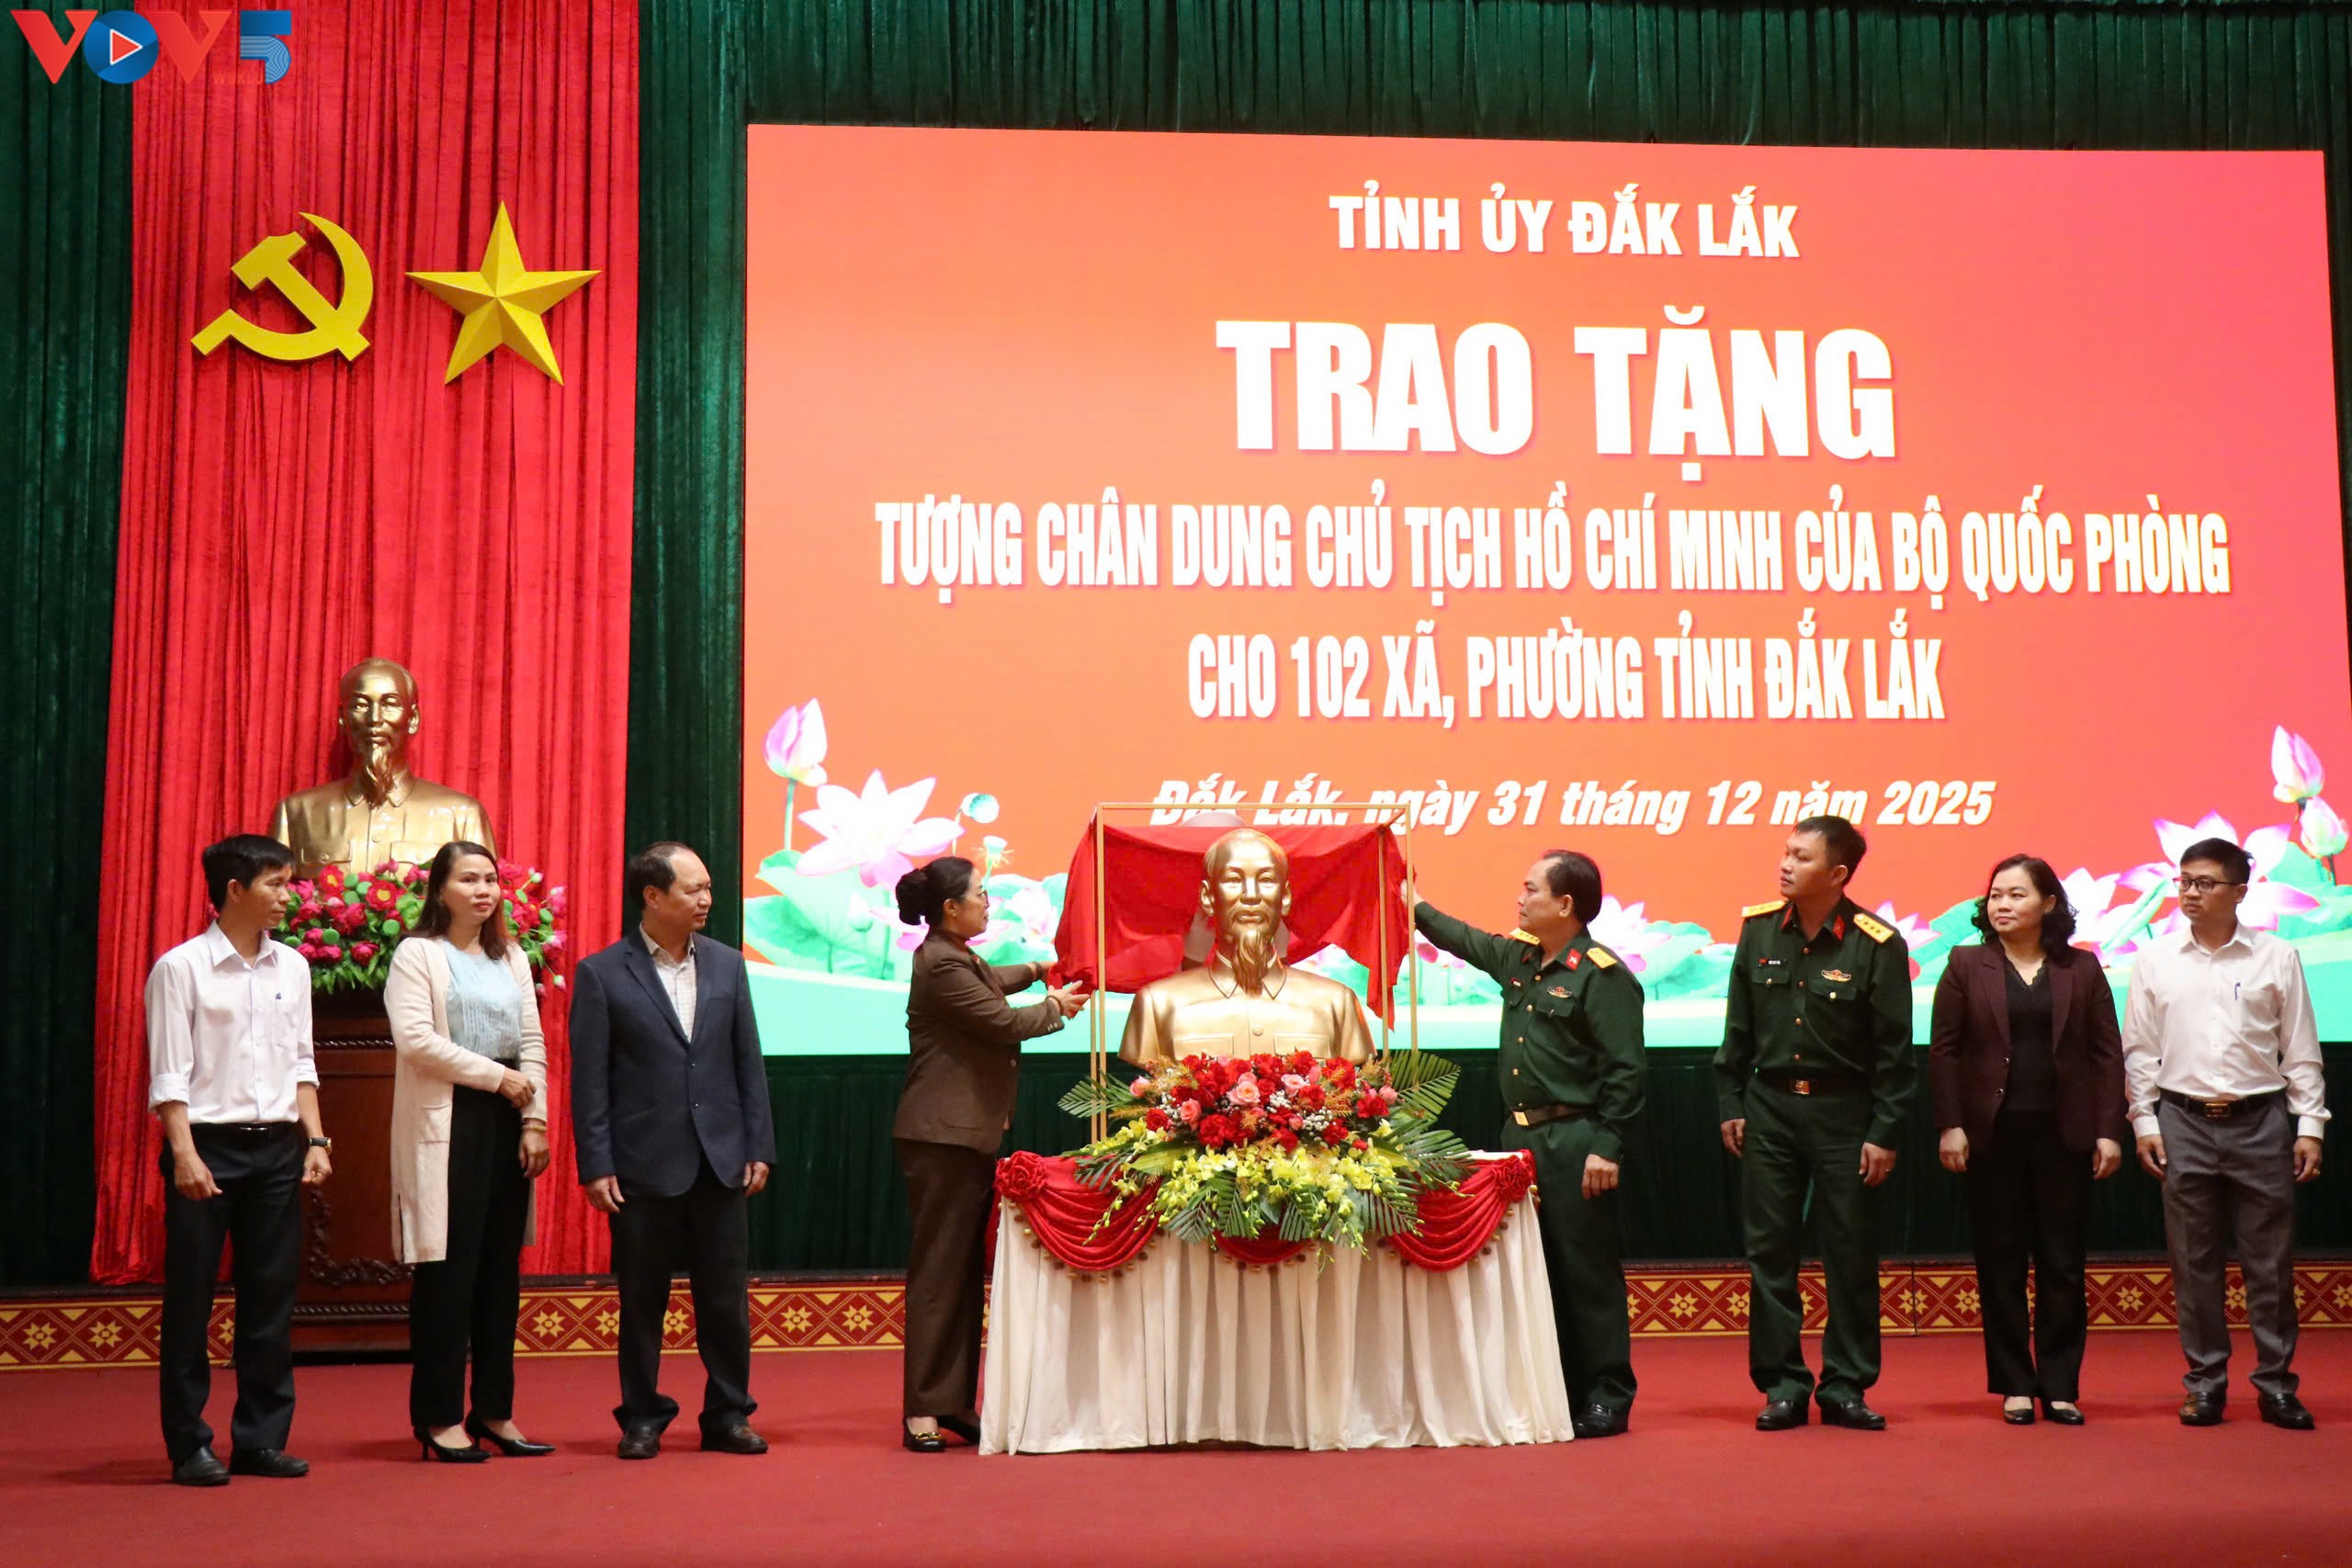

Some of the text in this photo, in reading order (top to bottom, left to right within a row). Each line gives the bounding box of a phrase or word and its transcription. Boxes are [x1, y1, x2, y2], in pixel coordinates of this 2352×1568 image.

[1329, 179, 1800, 258] TỈNH ỦY ĐẮK LẮK
[1216, 305, 1896, 482] TRAO TẶNG
[875, 479, 2231, 610] TƯỢNG CHÂN DUNG CHỦ TỊCH HỒ CHÍ MINH CỦA BỘ QUỐC PHÒNG
[1188, 607, 1945, 728] CHO 102 XÃ, PHƯỜNG TỈNH ĐẮK LẮK
[1149, 773, 1248, 826] Đắk
[1363, 779, 1481, 836] ngày
[1487, 779, 1548, 826] 31
[1560, 779, 1691, 835] tháng
[1706, 780, 1762, 825] 12
[1770, 780, 1868, 826] năm
[1876, 780, 1997, 826] 2025
